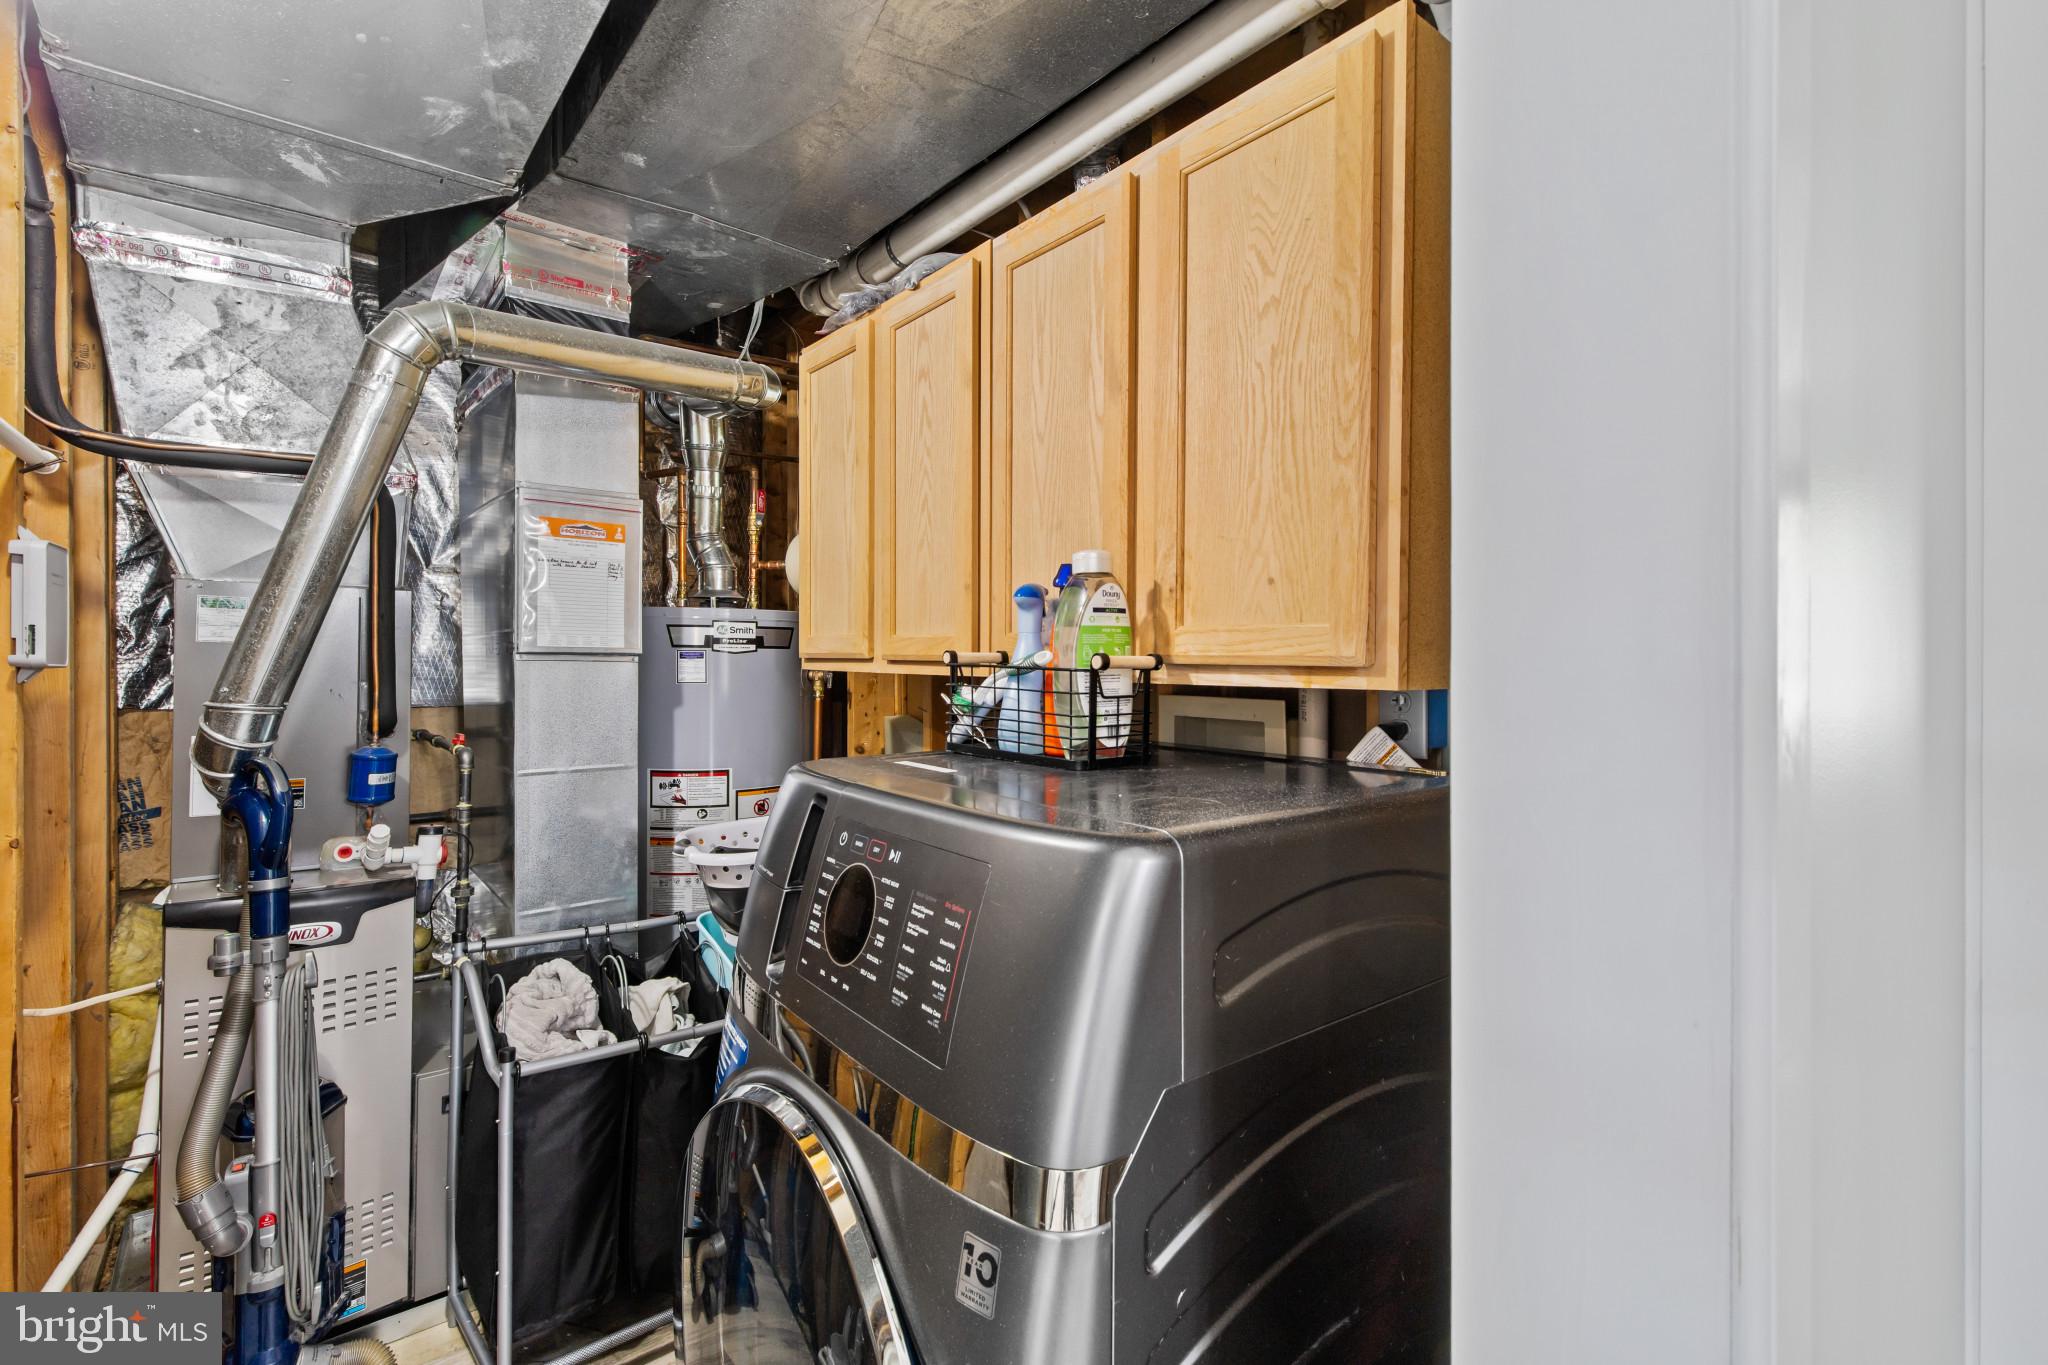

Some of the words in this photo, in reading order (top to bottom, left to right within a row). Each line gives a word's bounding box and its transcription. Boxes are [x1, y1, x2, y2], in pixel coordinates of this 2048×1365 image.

[283, 272, 312, 286] Q4/23
[1102, 590, 1120, 600] Downy
[729, 626, 754, 634] Smith
[965, 1286, 986, 1301] LIMITED
[960, 1291, 989, 1311] WARRANTY
